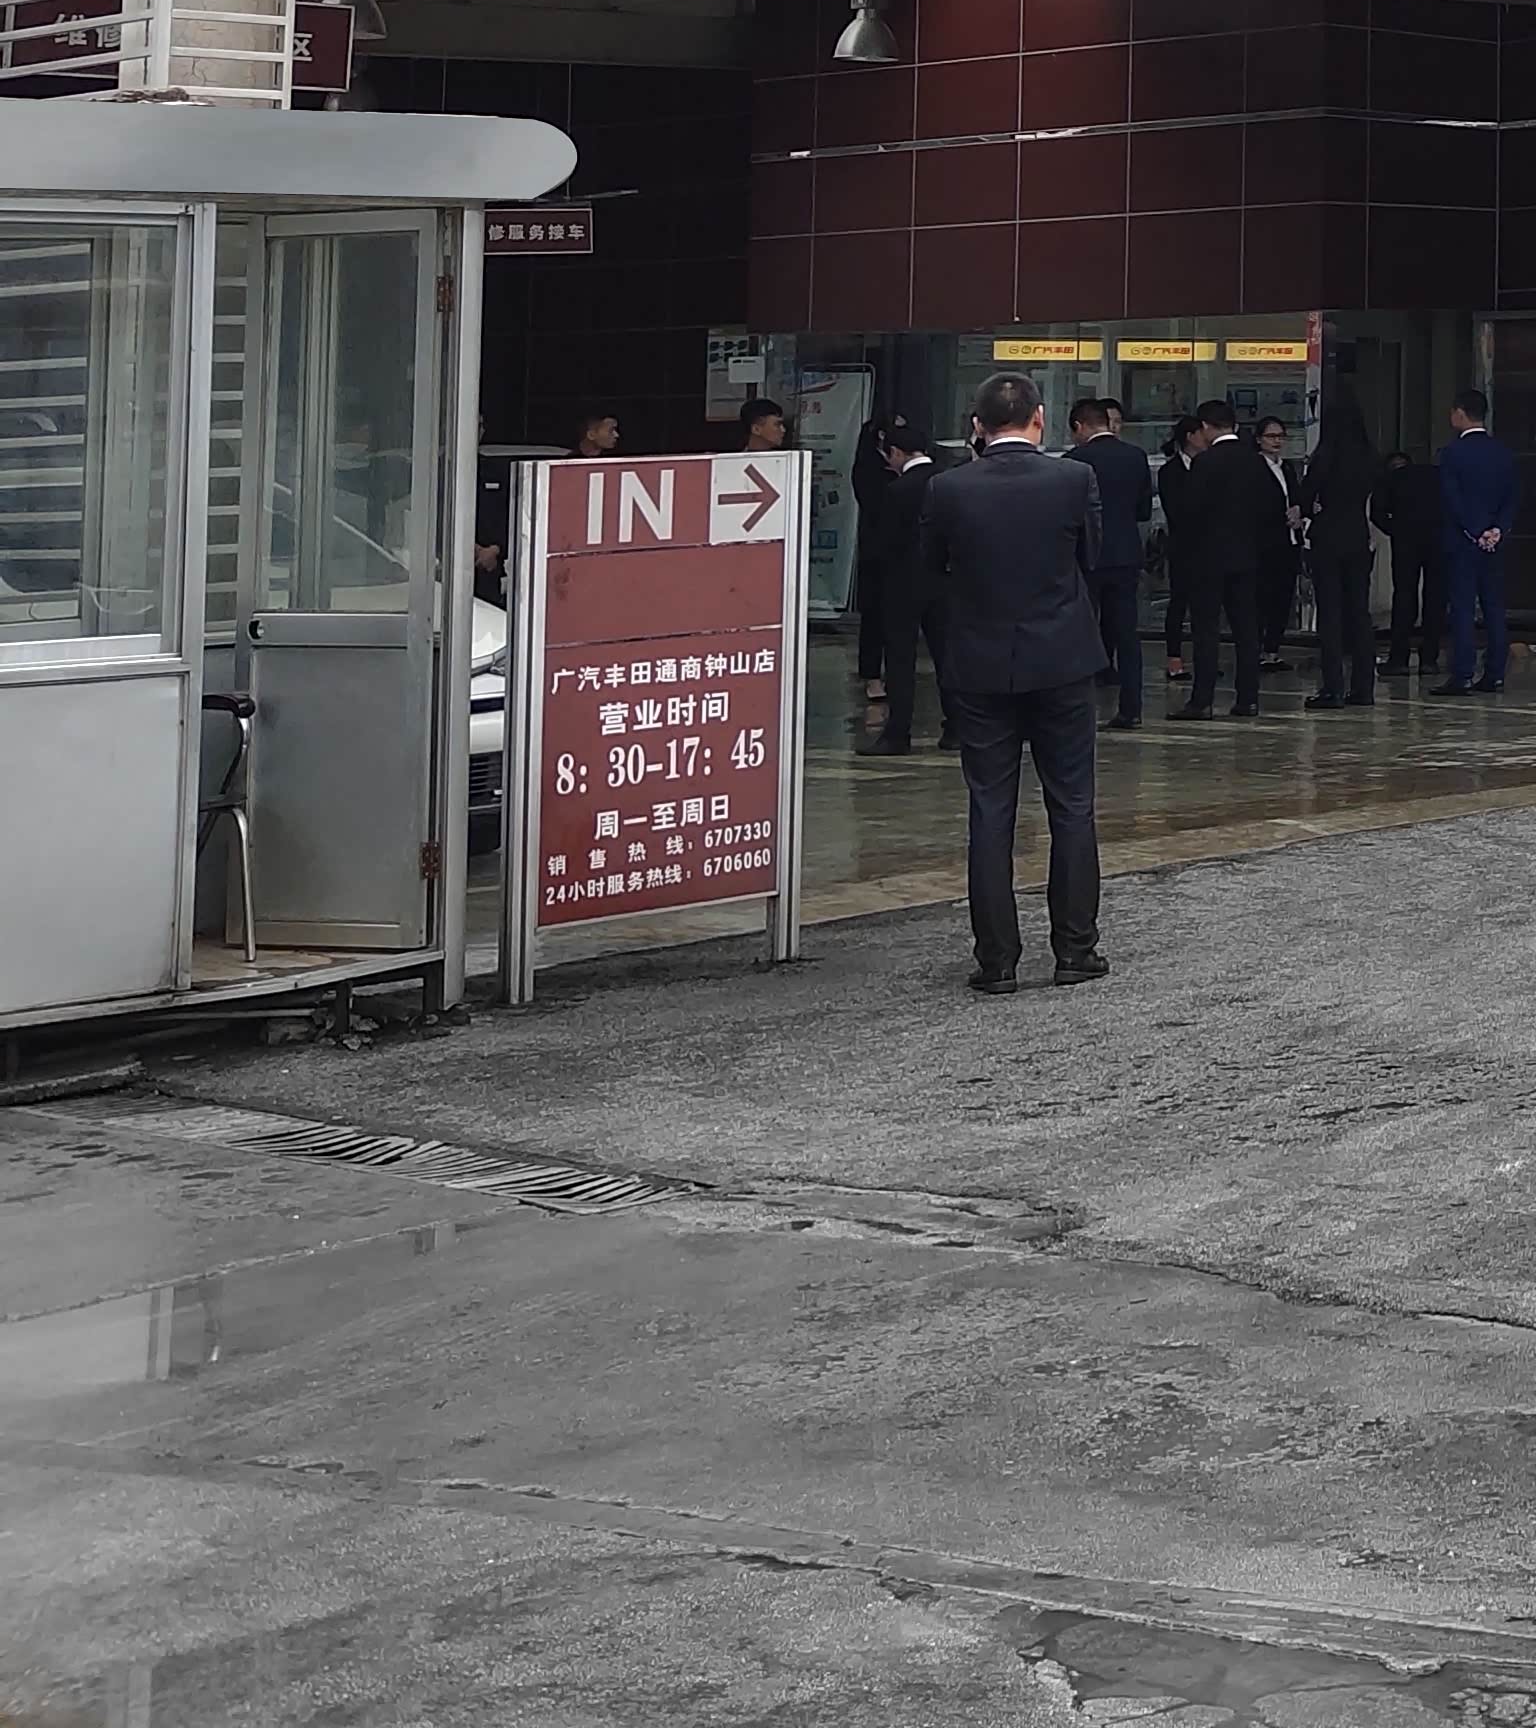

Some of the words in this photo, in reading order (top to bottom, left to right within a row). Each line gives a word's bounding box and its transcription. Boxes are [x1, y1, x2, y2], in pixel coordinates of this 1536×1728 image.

[586, 469, 675, 545] IN
[551, 649, 776, 694] 广汽丰田通商钟山店
[599, 691, 730, 736] 营业时间
[593, 794, 731, 842] 周一至周日
[704, 819, 773, 850] 6707330
[703, 847, 773, 878] 6706060
